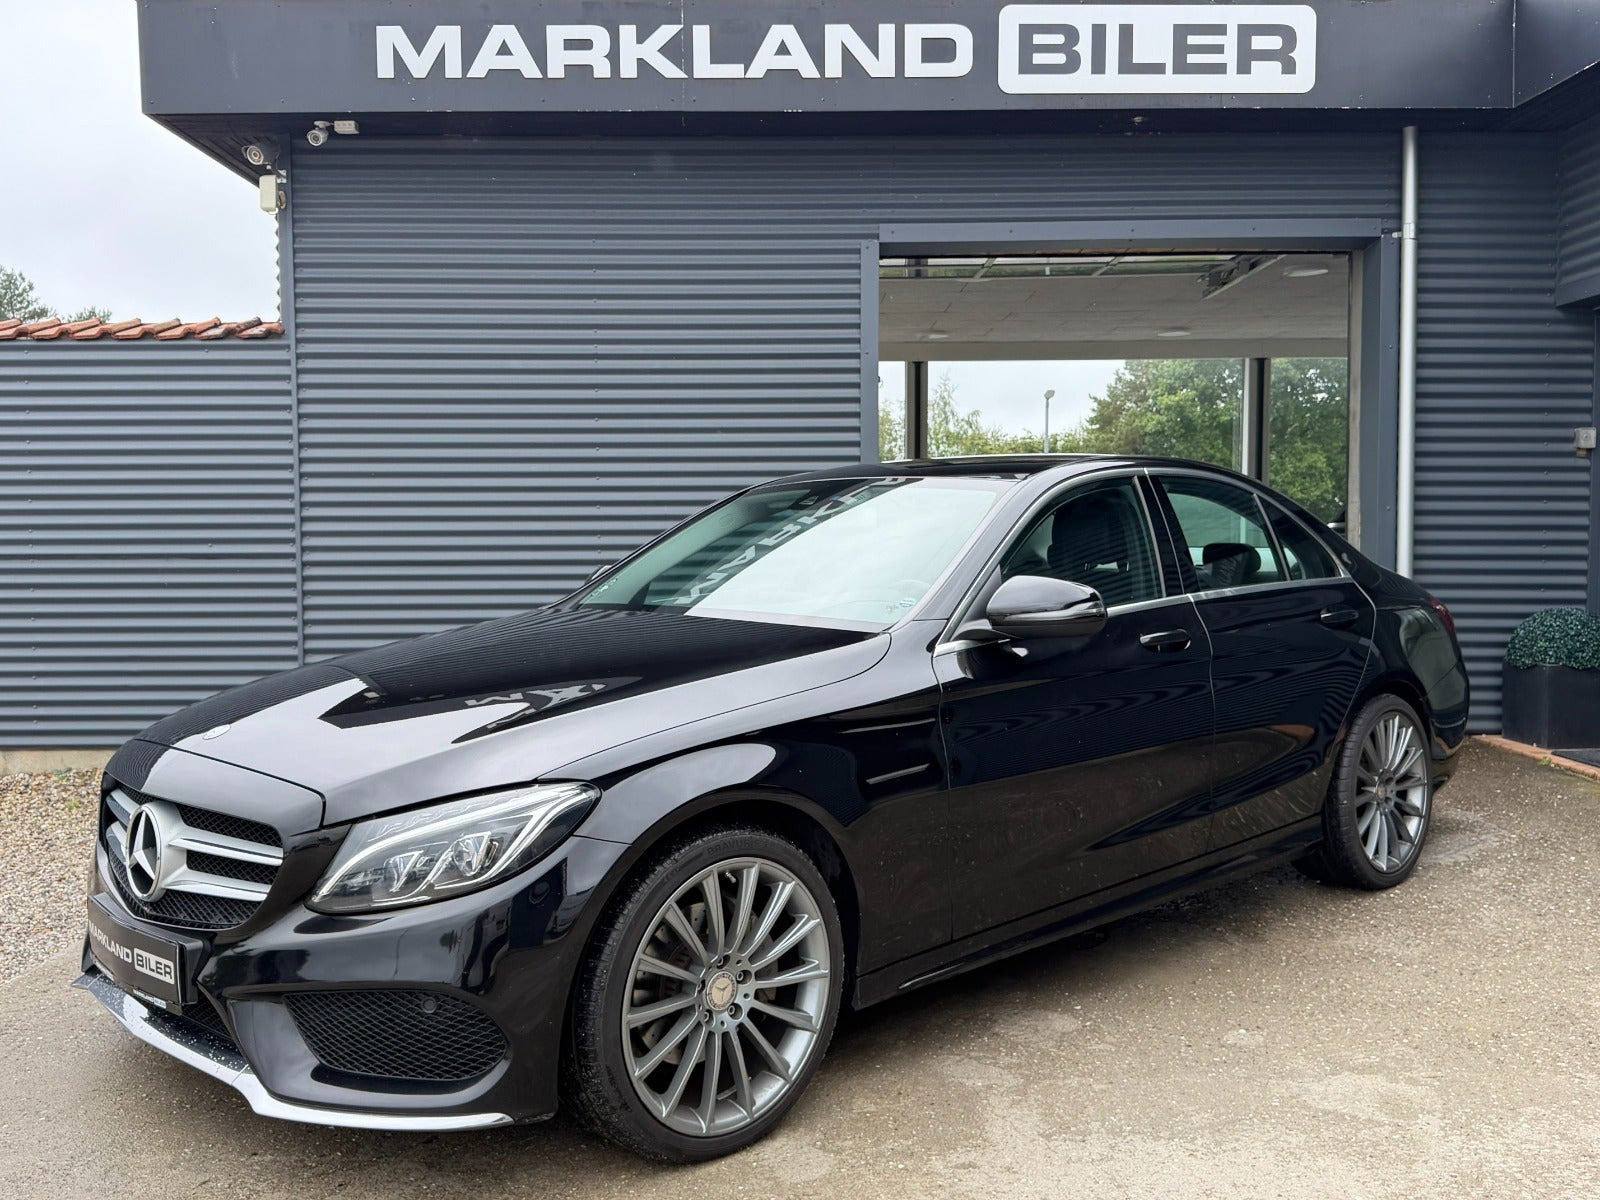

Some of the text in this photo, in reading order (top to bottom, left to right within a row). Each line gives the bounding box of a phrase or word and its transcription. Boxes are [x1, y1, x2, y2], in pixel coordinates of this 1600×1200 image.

[375, 22, 1298, 80] MARKLAND BILER
[88, 920, 173, 980] MARKLAND BILER
